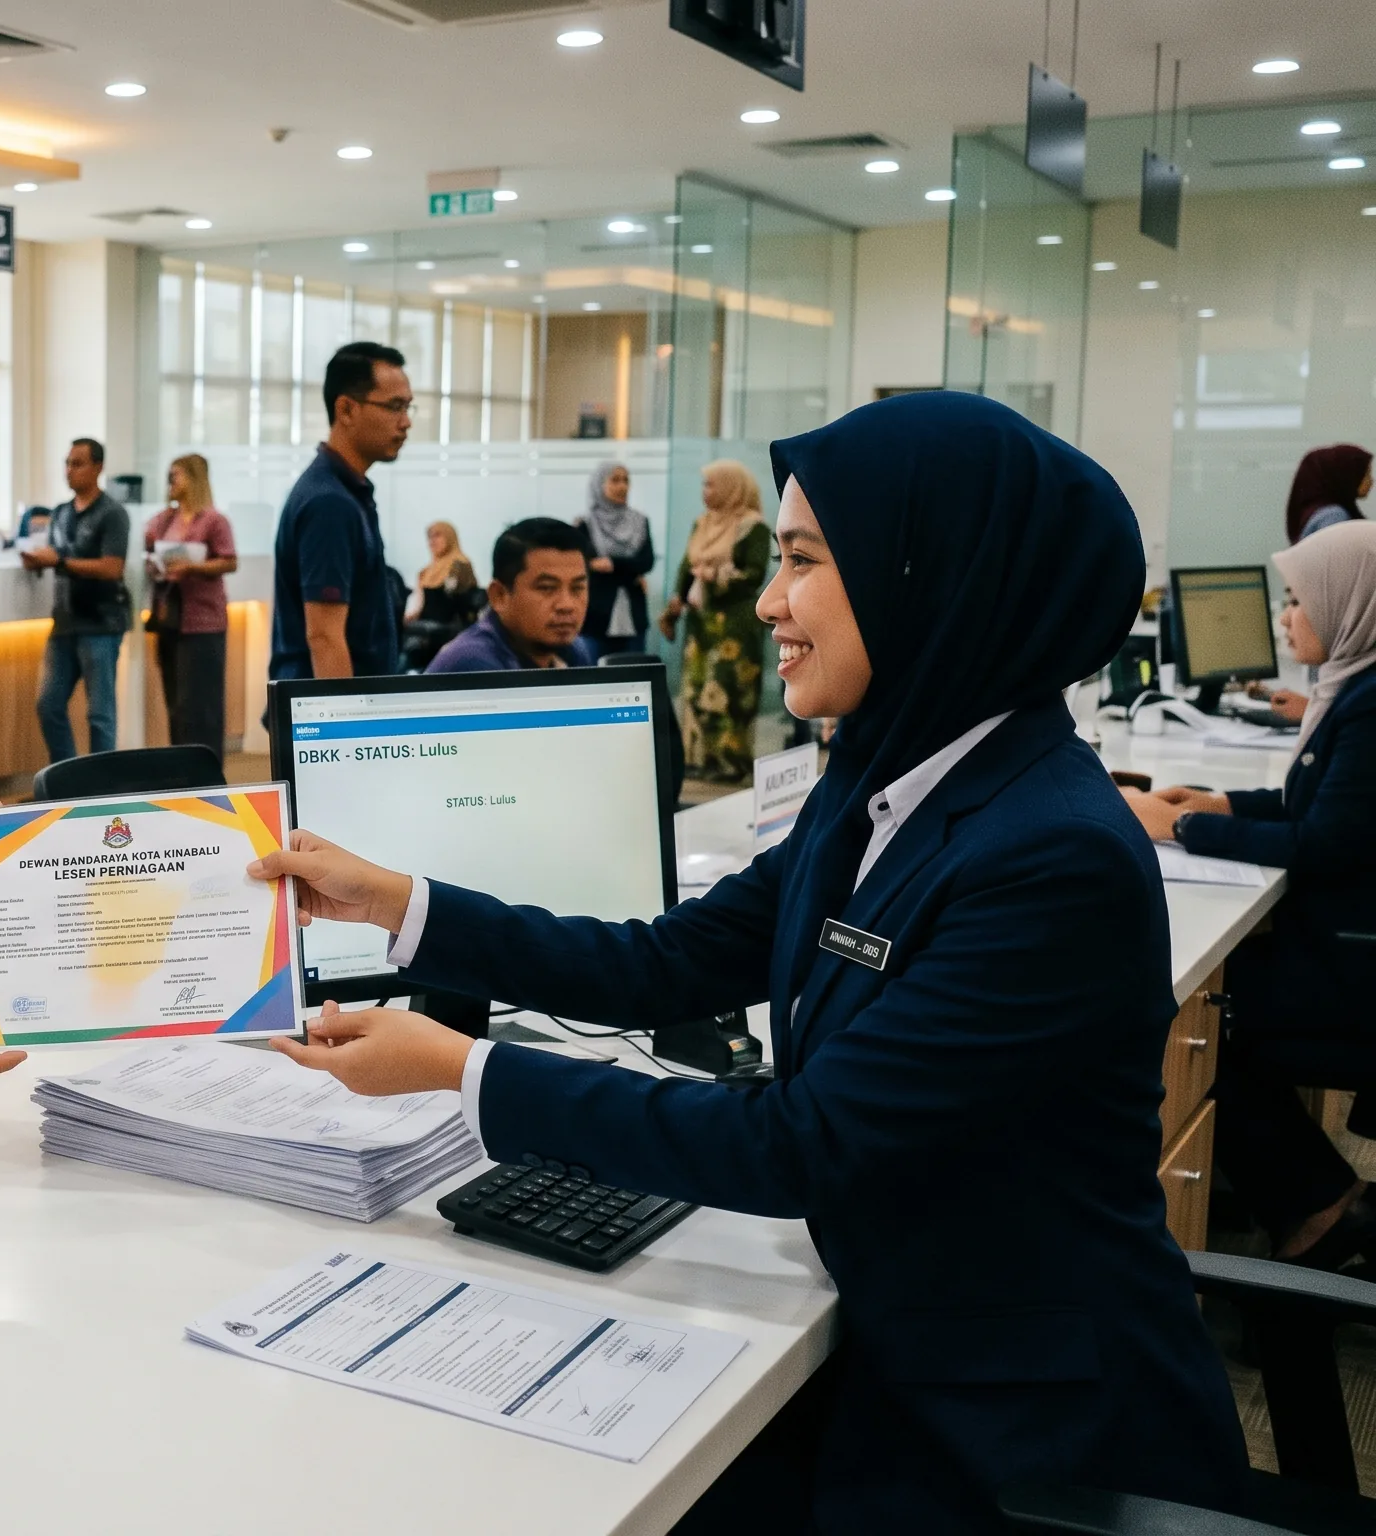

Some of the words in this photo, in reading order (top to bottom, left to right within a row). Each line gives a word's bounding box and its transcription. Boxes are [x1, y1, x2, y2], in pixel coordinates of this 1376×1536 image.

[299, 748, 341, 764] DBKK
[355, 745, 415, 761] STATUS:
[419, 742, 458, 758] Lulus
[446, 796, 487, 808] STATUS:
[490, 794, 517, 806] Lulus
[19, 857, 59, 870] DEWAN
[62, 853, 128, 867] BANDARAYA
[131, 850, 161, 863] KOTA
[163, 845, 221, 860] KINABALU
[54, 867, 96, 881] LESEN
[99, 861, 185, 877] PERNIAGAAN
